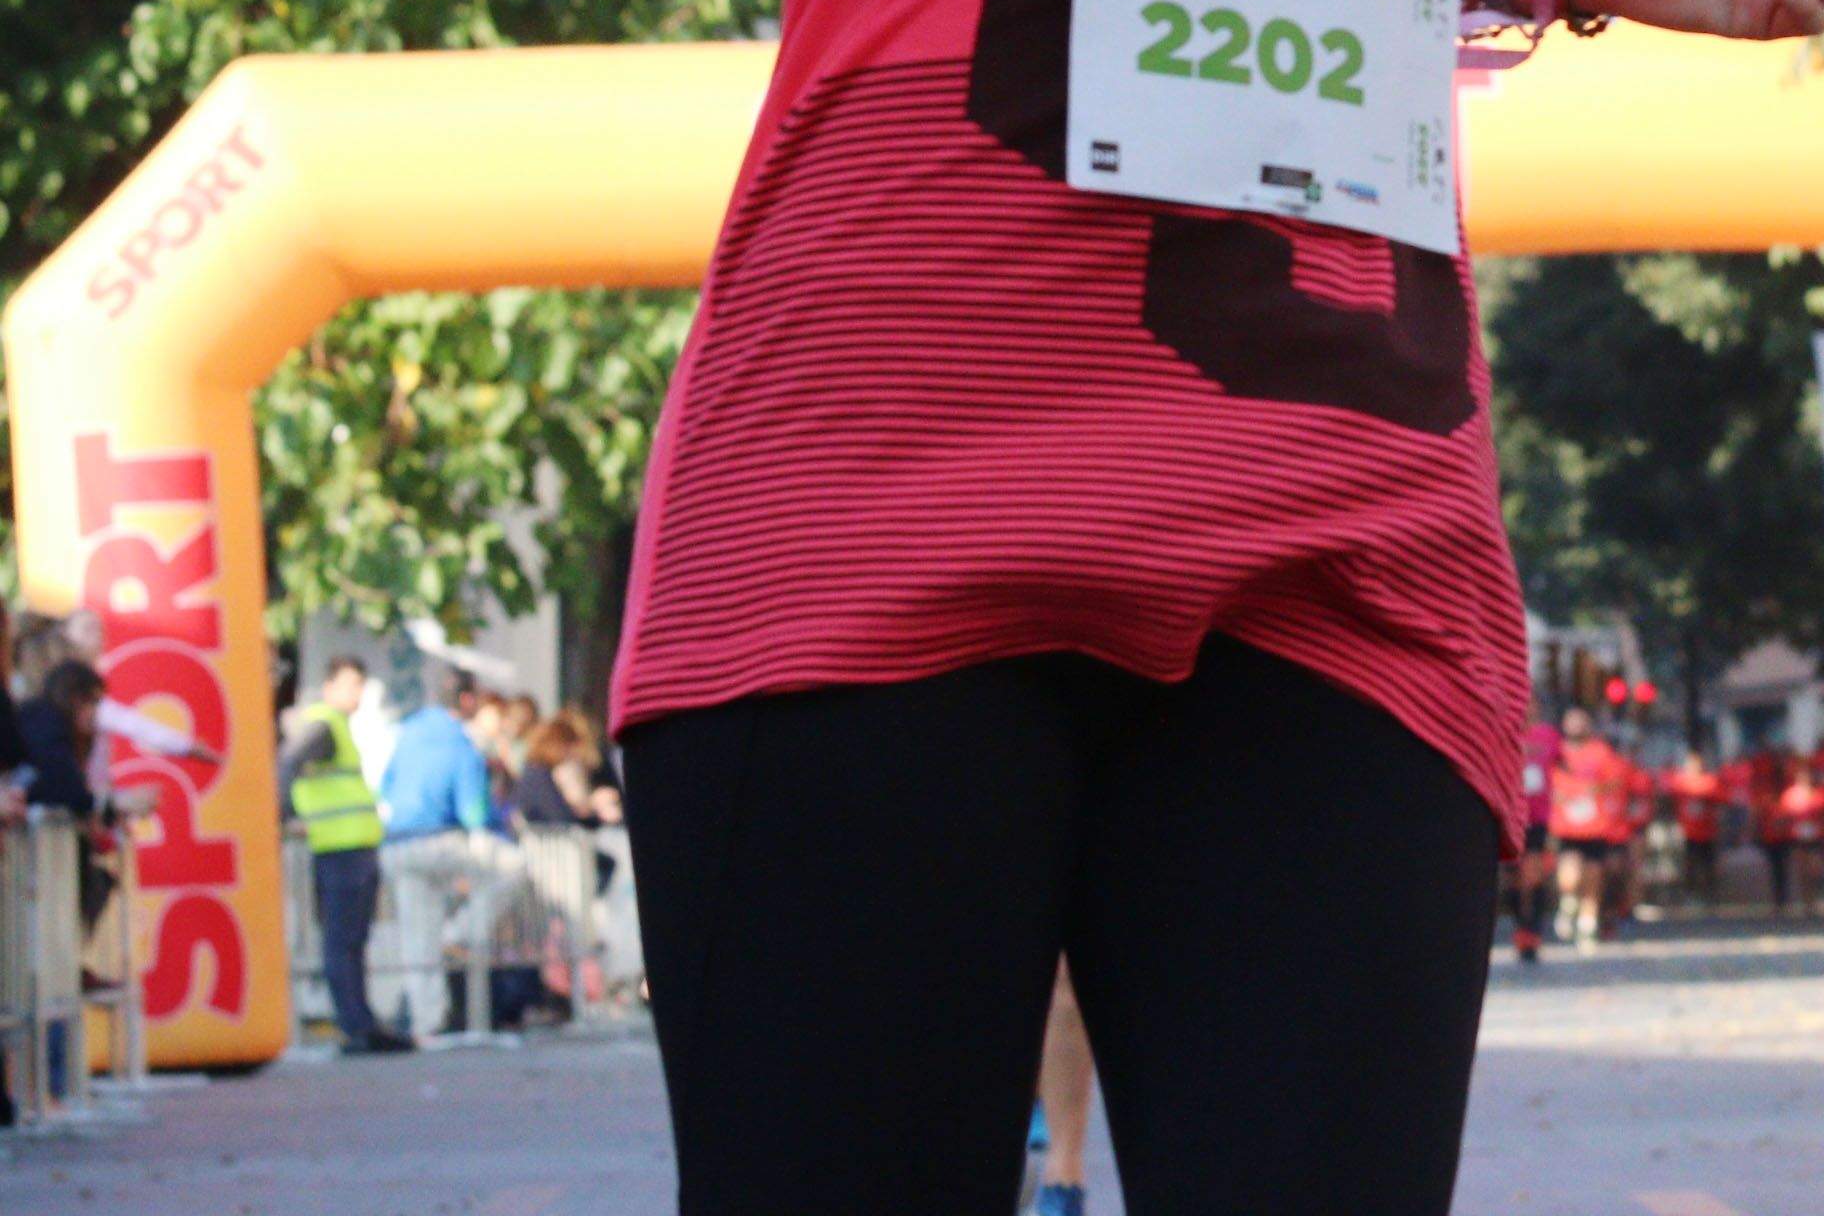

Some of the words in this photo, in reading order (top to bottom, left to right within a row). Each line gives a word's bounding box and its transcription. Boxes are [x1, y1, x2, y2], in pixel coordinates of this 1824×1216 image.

[1137, 0, 1365, 107] 2202
[86, 126, 264, 321] SPORT
[74, 431, 247, 1025] SPORT
